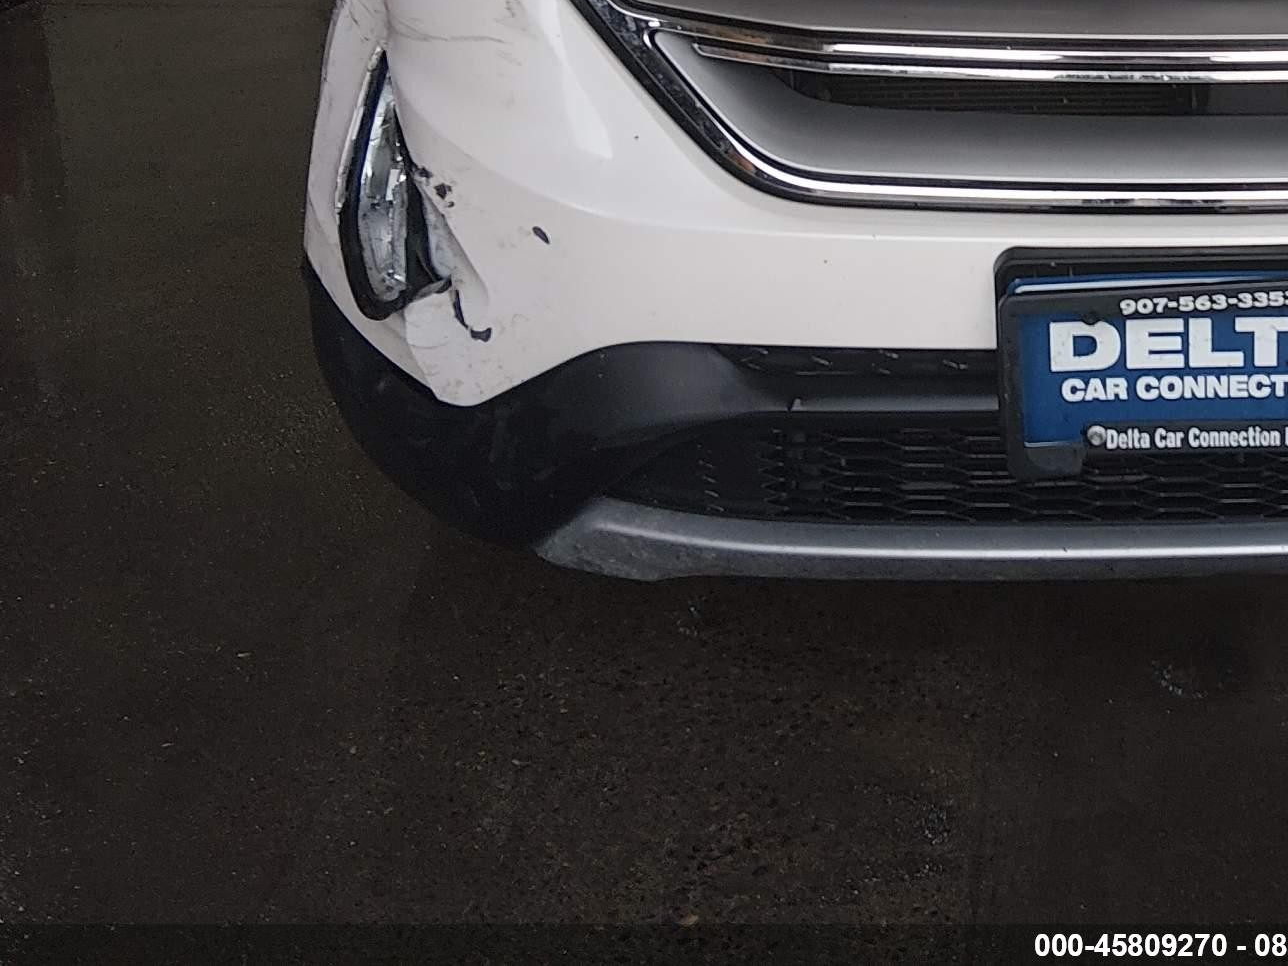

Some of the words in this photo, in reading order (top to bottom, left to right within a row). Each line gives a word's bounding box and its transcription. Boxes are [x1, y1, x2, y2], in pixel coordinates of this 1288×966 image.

[1061, 378, 1129, 402] CAR
[1106, 427, 1151, 450] Delta
[1155, 427, 1184, 448] Car
[1189, 425, 1281, 447] Connection
